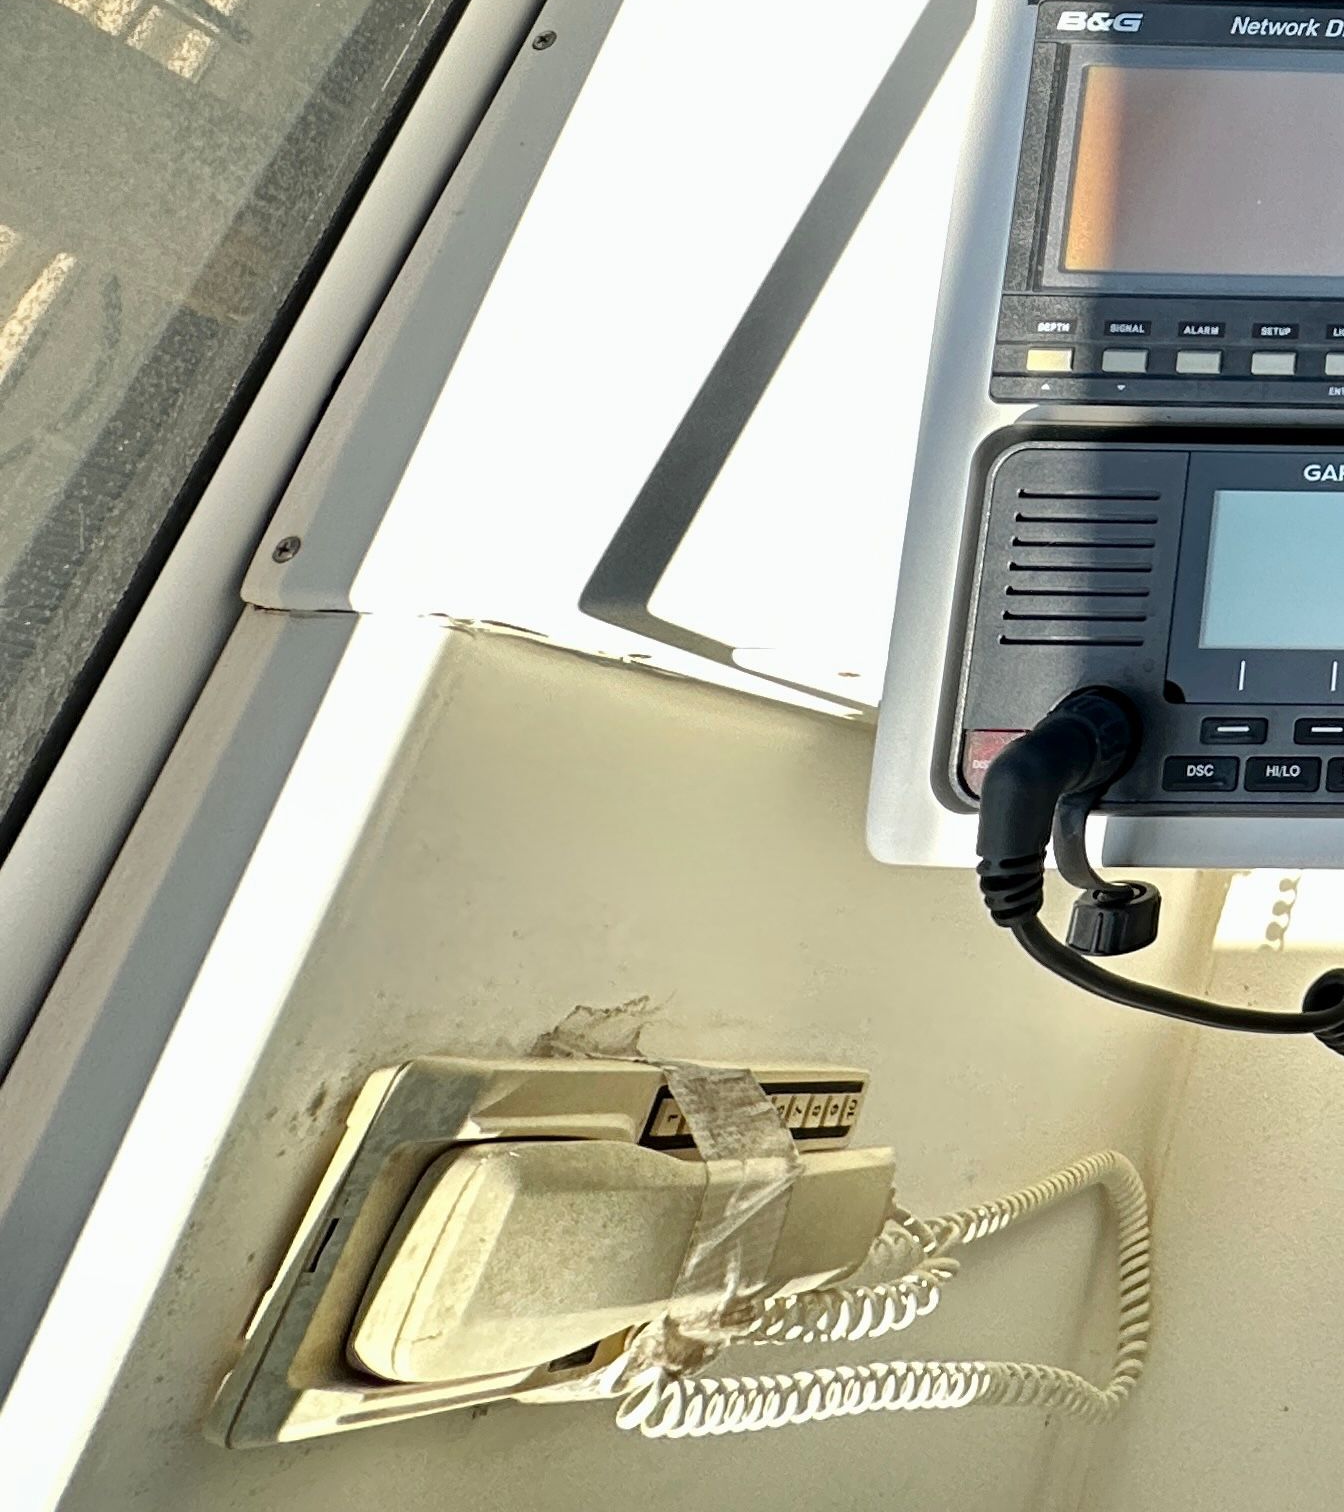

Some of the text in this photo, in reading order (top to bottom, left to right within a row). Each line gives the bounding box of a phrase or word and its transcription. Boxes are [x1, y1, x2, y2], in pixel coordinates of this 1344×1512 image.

[1057, 11, 1144, 32] B&G
[1230, 16, 1319, 37] Network
[1037, 322, 1070, 333] DEPTH
[1110, 323, 1145, 334] SIGNAL
[1183, 325, 1219, 336] ALARM
[1261, 326, 1292, 336] SETUP
[1186, 765, 1214, 778] DSC
[1265, 765, 1301, 778] HI/LO
